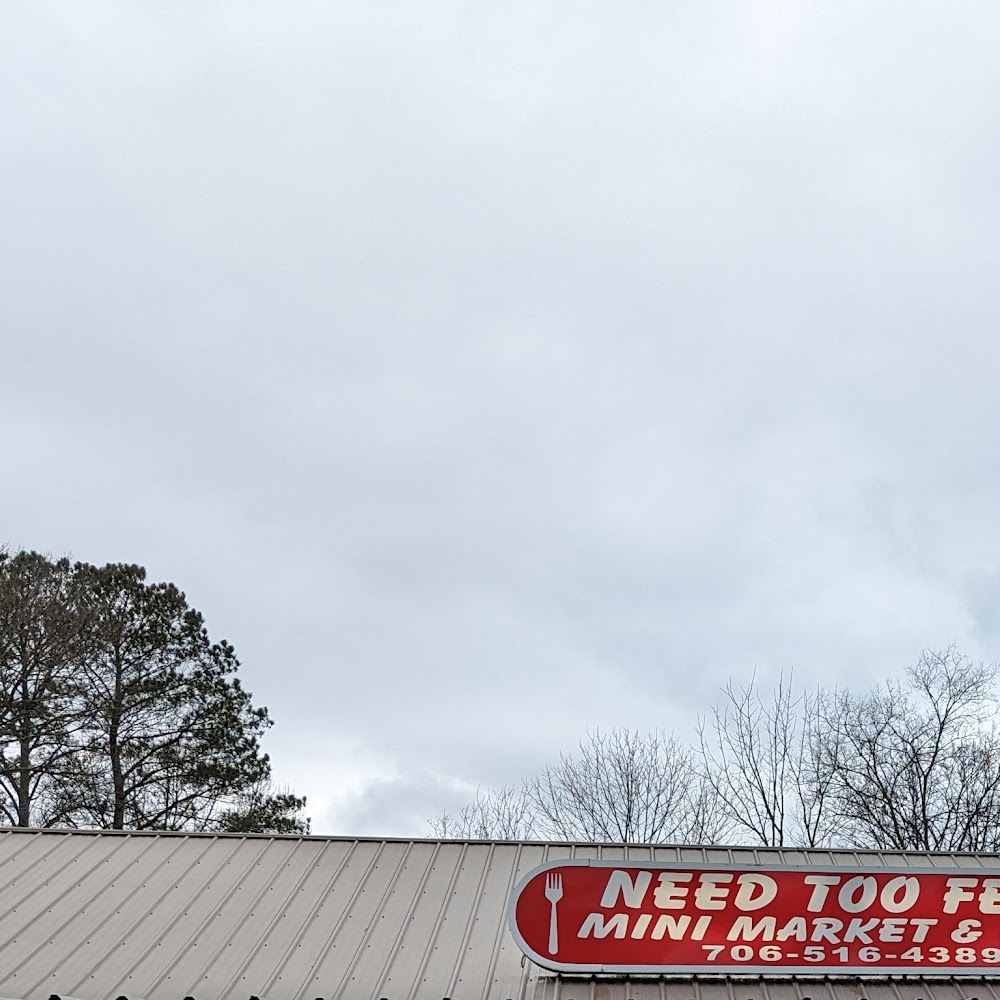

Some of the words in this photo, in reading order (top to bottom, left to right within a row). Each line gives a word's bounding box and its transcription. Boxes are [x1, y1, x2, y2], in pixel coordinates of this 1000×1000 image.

[600, 870, 778, 912] NEED
[803, 875, 921, 914] TOO
[577, 913, 712, 941] MINI
[726, 916, 939, 944] MARKET
[951, 919, 983, 943] &
